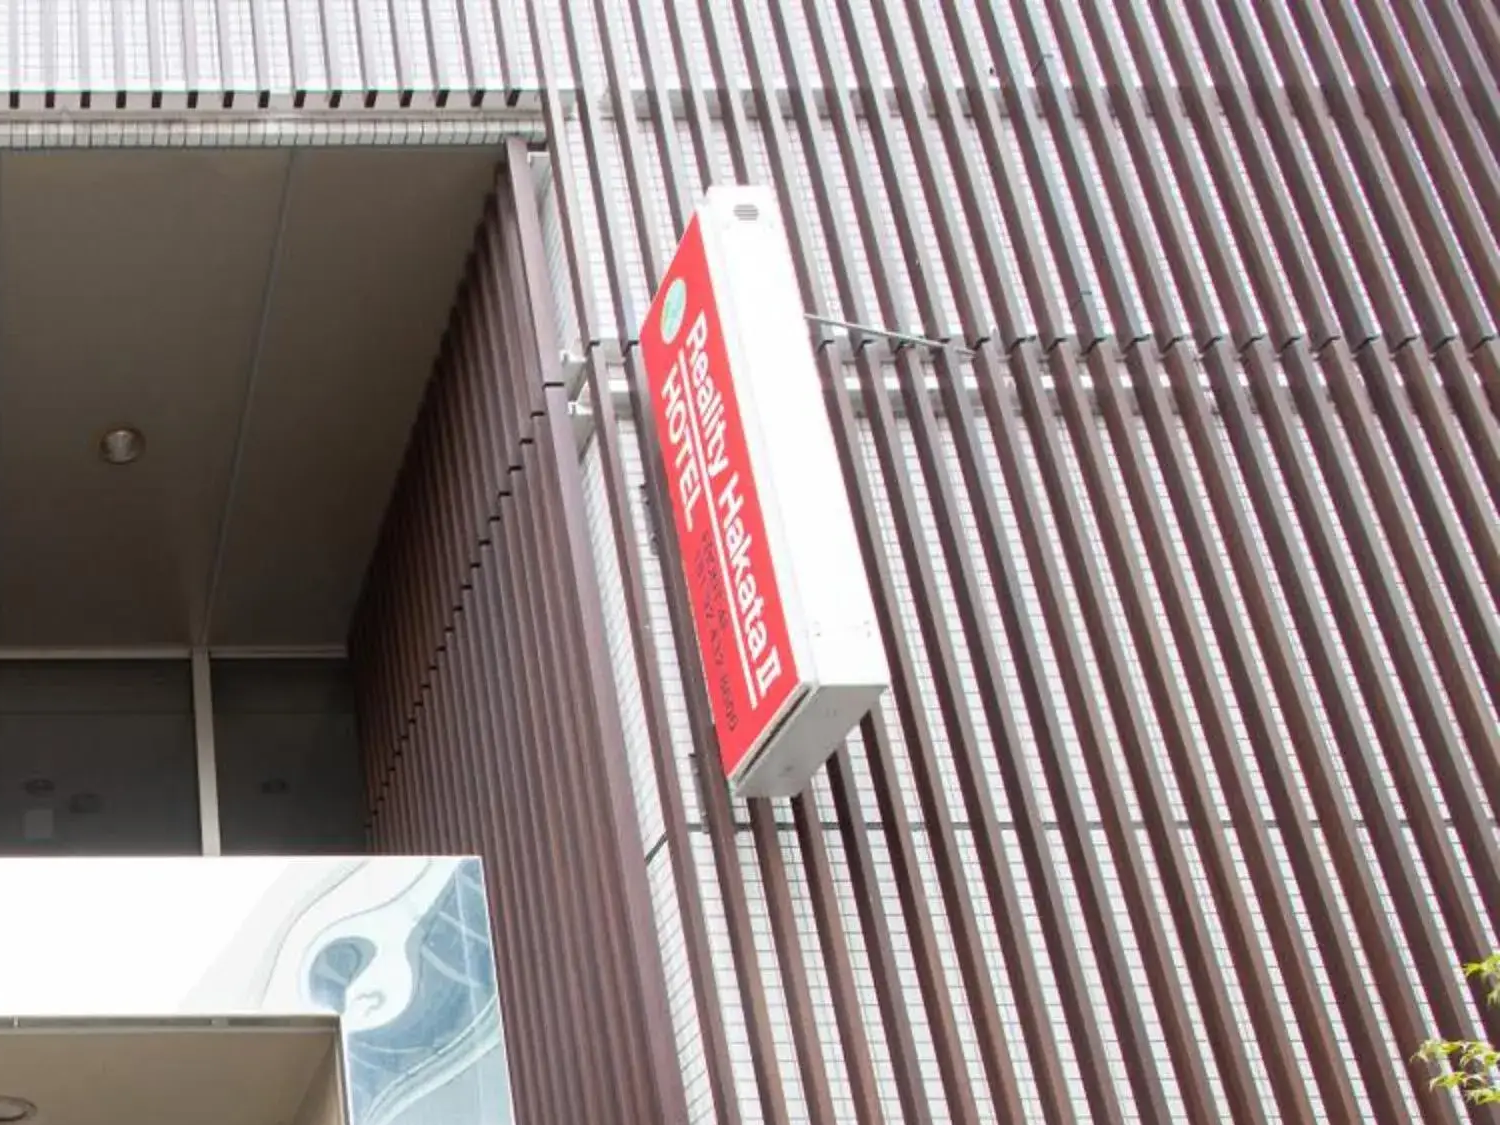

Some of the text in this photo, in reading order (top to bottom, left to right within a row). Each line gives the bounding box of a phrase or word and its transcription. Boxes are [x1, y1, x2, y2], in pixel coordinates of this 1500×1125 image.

[661, 363, 702, 532] HOTEL
[686, 311, 728, 477] Reality
[719, 474, 767, 661] Hakata
